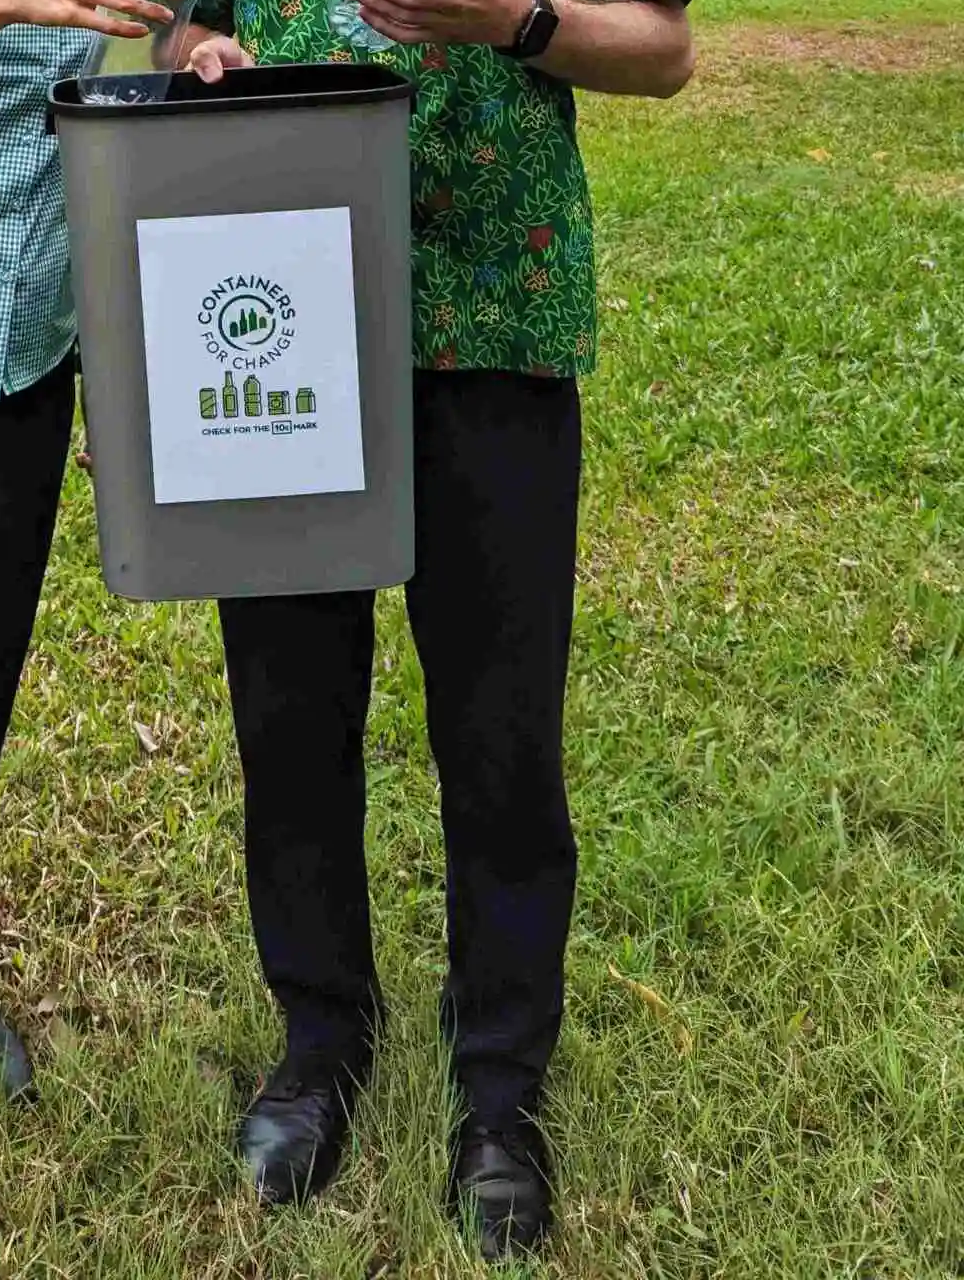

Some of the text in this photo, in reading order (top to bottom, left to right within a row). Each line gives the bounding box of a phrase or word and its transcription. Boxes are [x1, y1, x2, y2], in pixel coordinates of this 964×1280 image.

[198, 274, 296, 324] CONTAINERS
[201, 327, 295, 369] FOR CHANGE
[202, 427, 231, 436] CHECK
[234, 426, 251, 434] FOR
[253, 424, 269, 433] THE
[293, 422, 317, 430] MARK
